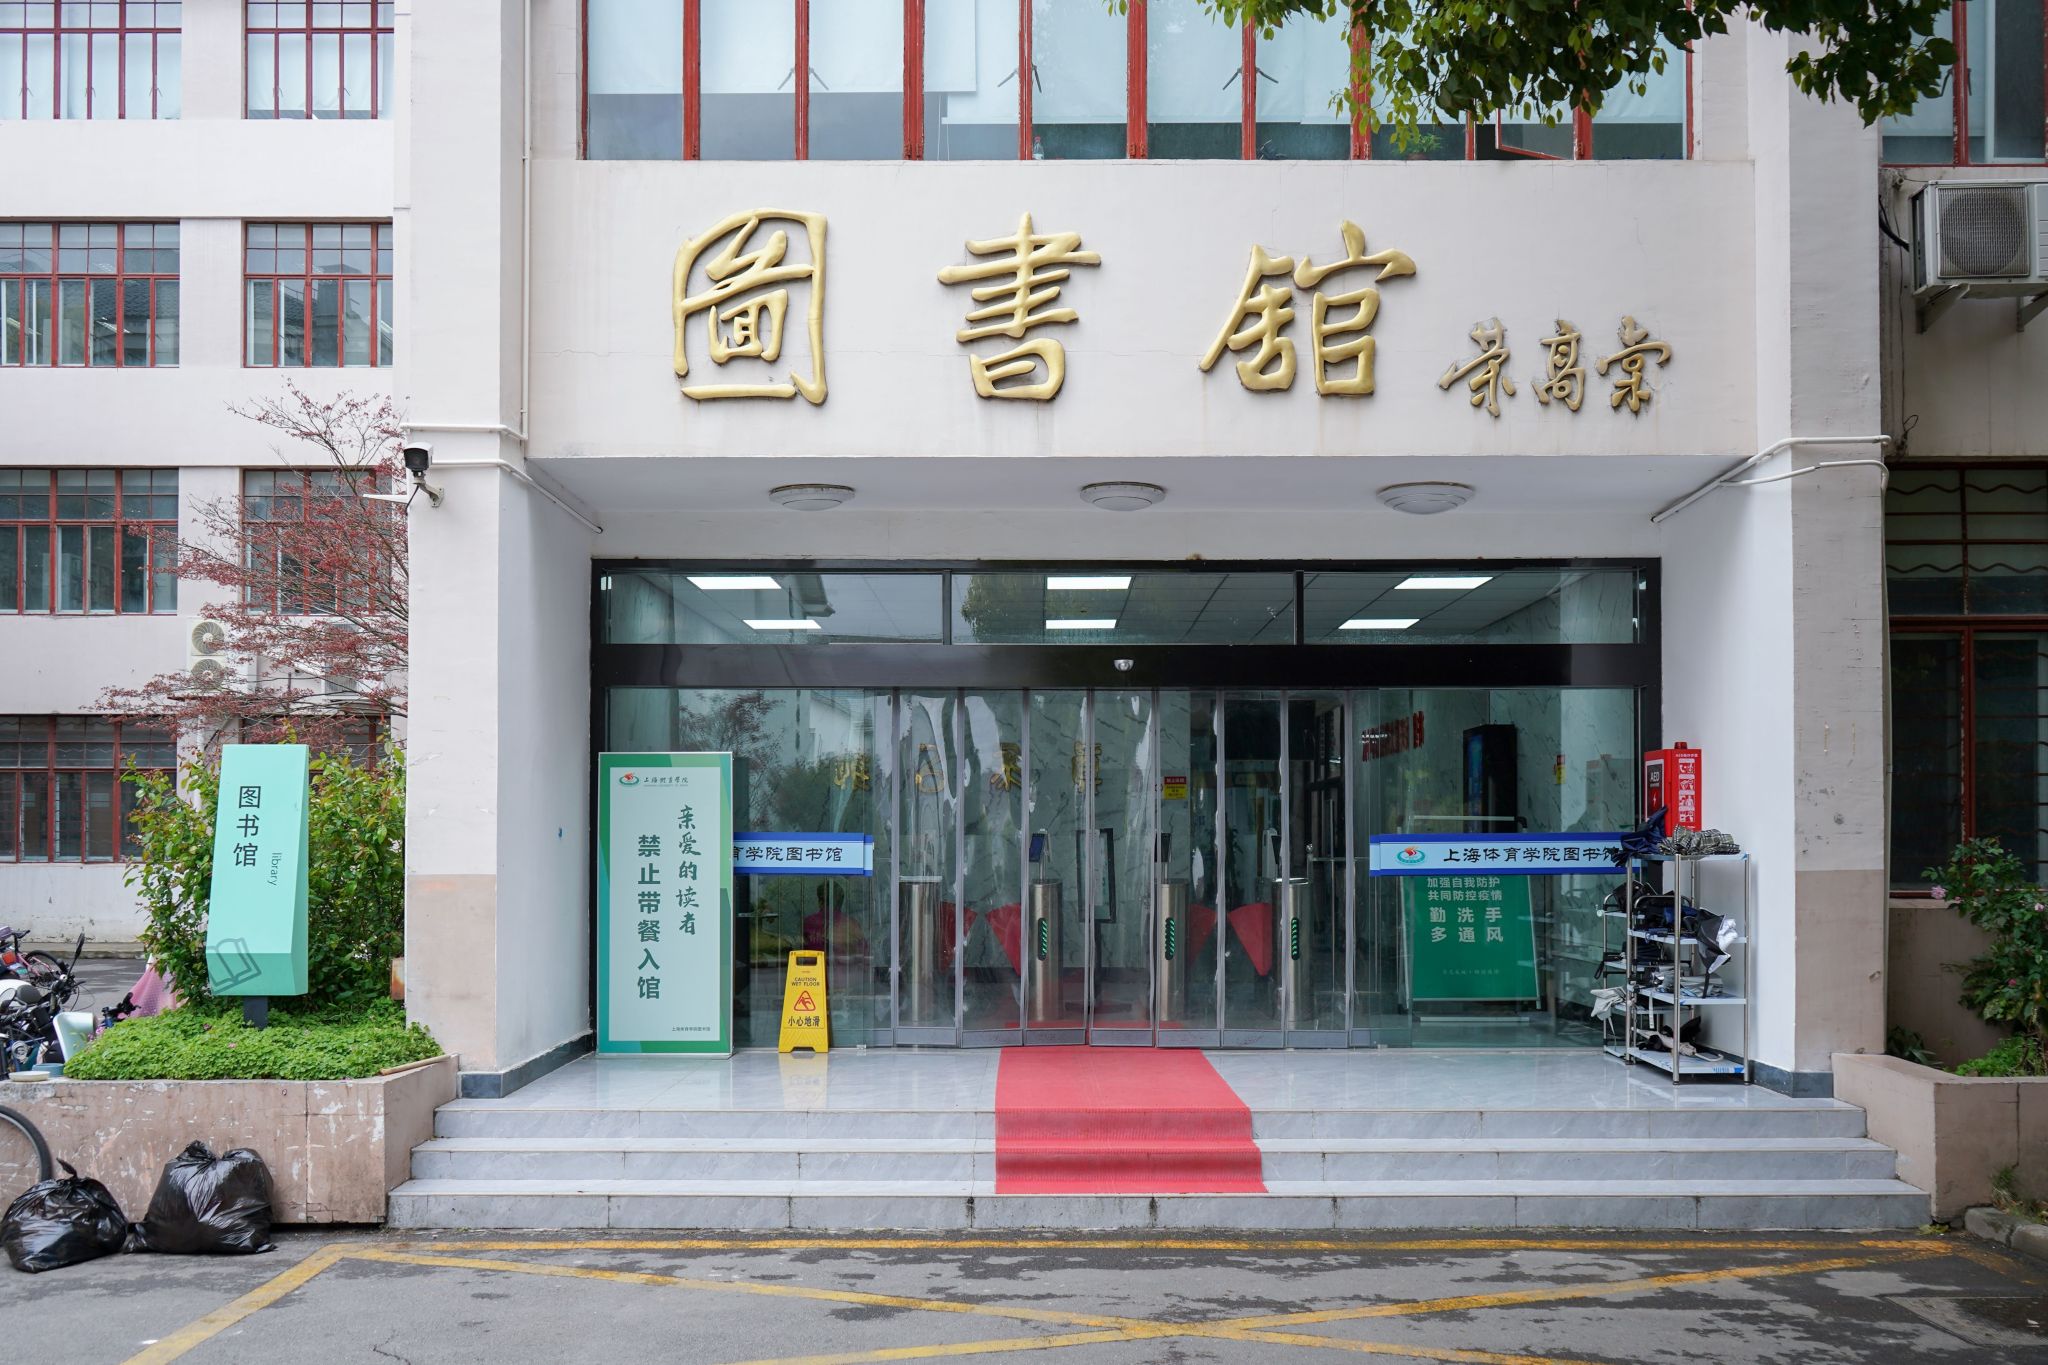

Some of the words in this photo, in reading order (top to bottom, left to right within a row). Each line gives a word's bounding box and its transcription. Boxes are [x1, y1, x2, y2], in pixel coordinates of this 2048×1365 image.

[233, 786, 261, 867] 图书馆
[267, 852, 282, 886] library
[676, 804, 702, 936] 亲爱的读者
[1427, 877, 1501, 888] 加强自我防护
[1428, 890, 1503, 901] 共同防控疫情
[637, 834, 661, 1000] 禁止带餐入馆
[788, 1016, 821, 1027] 小心地滑
